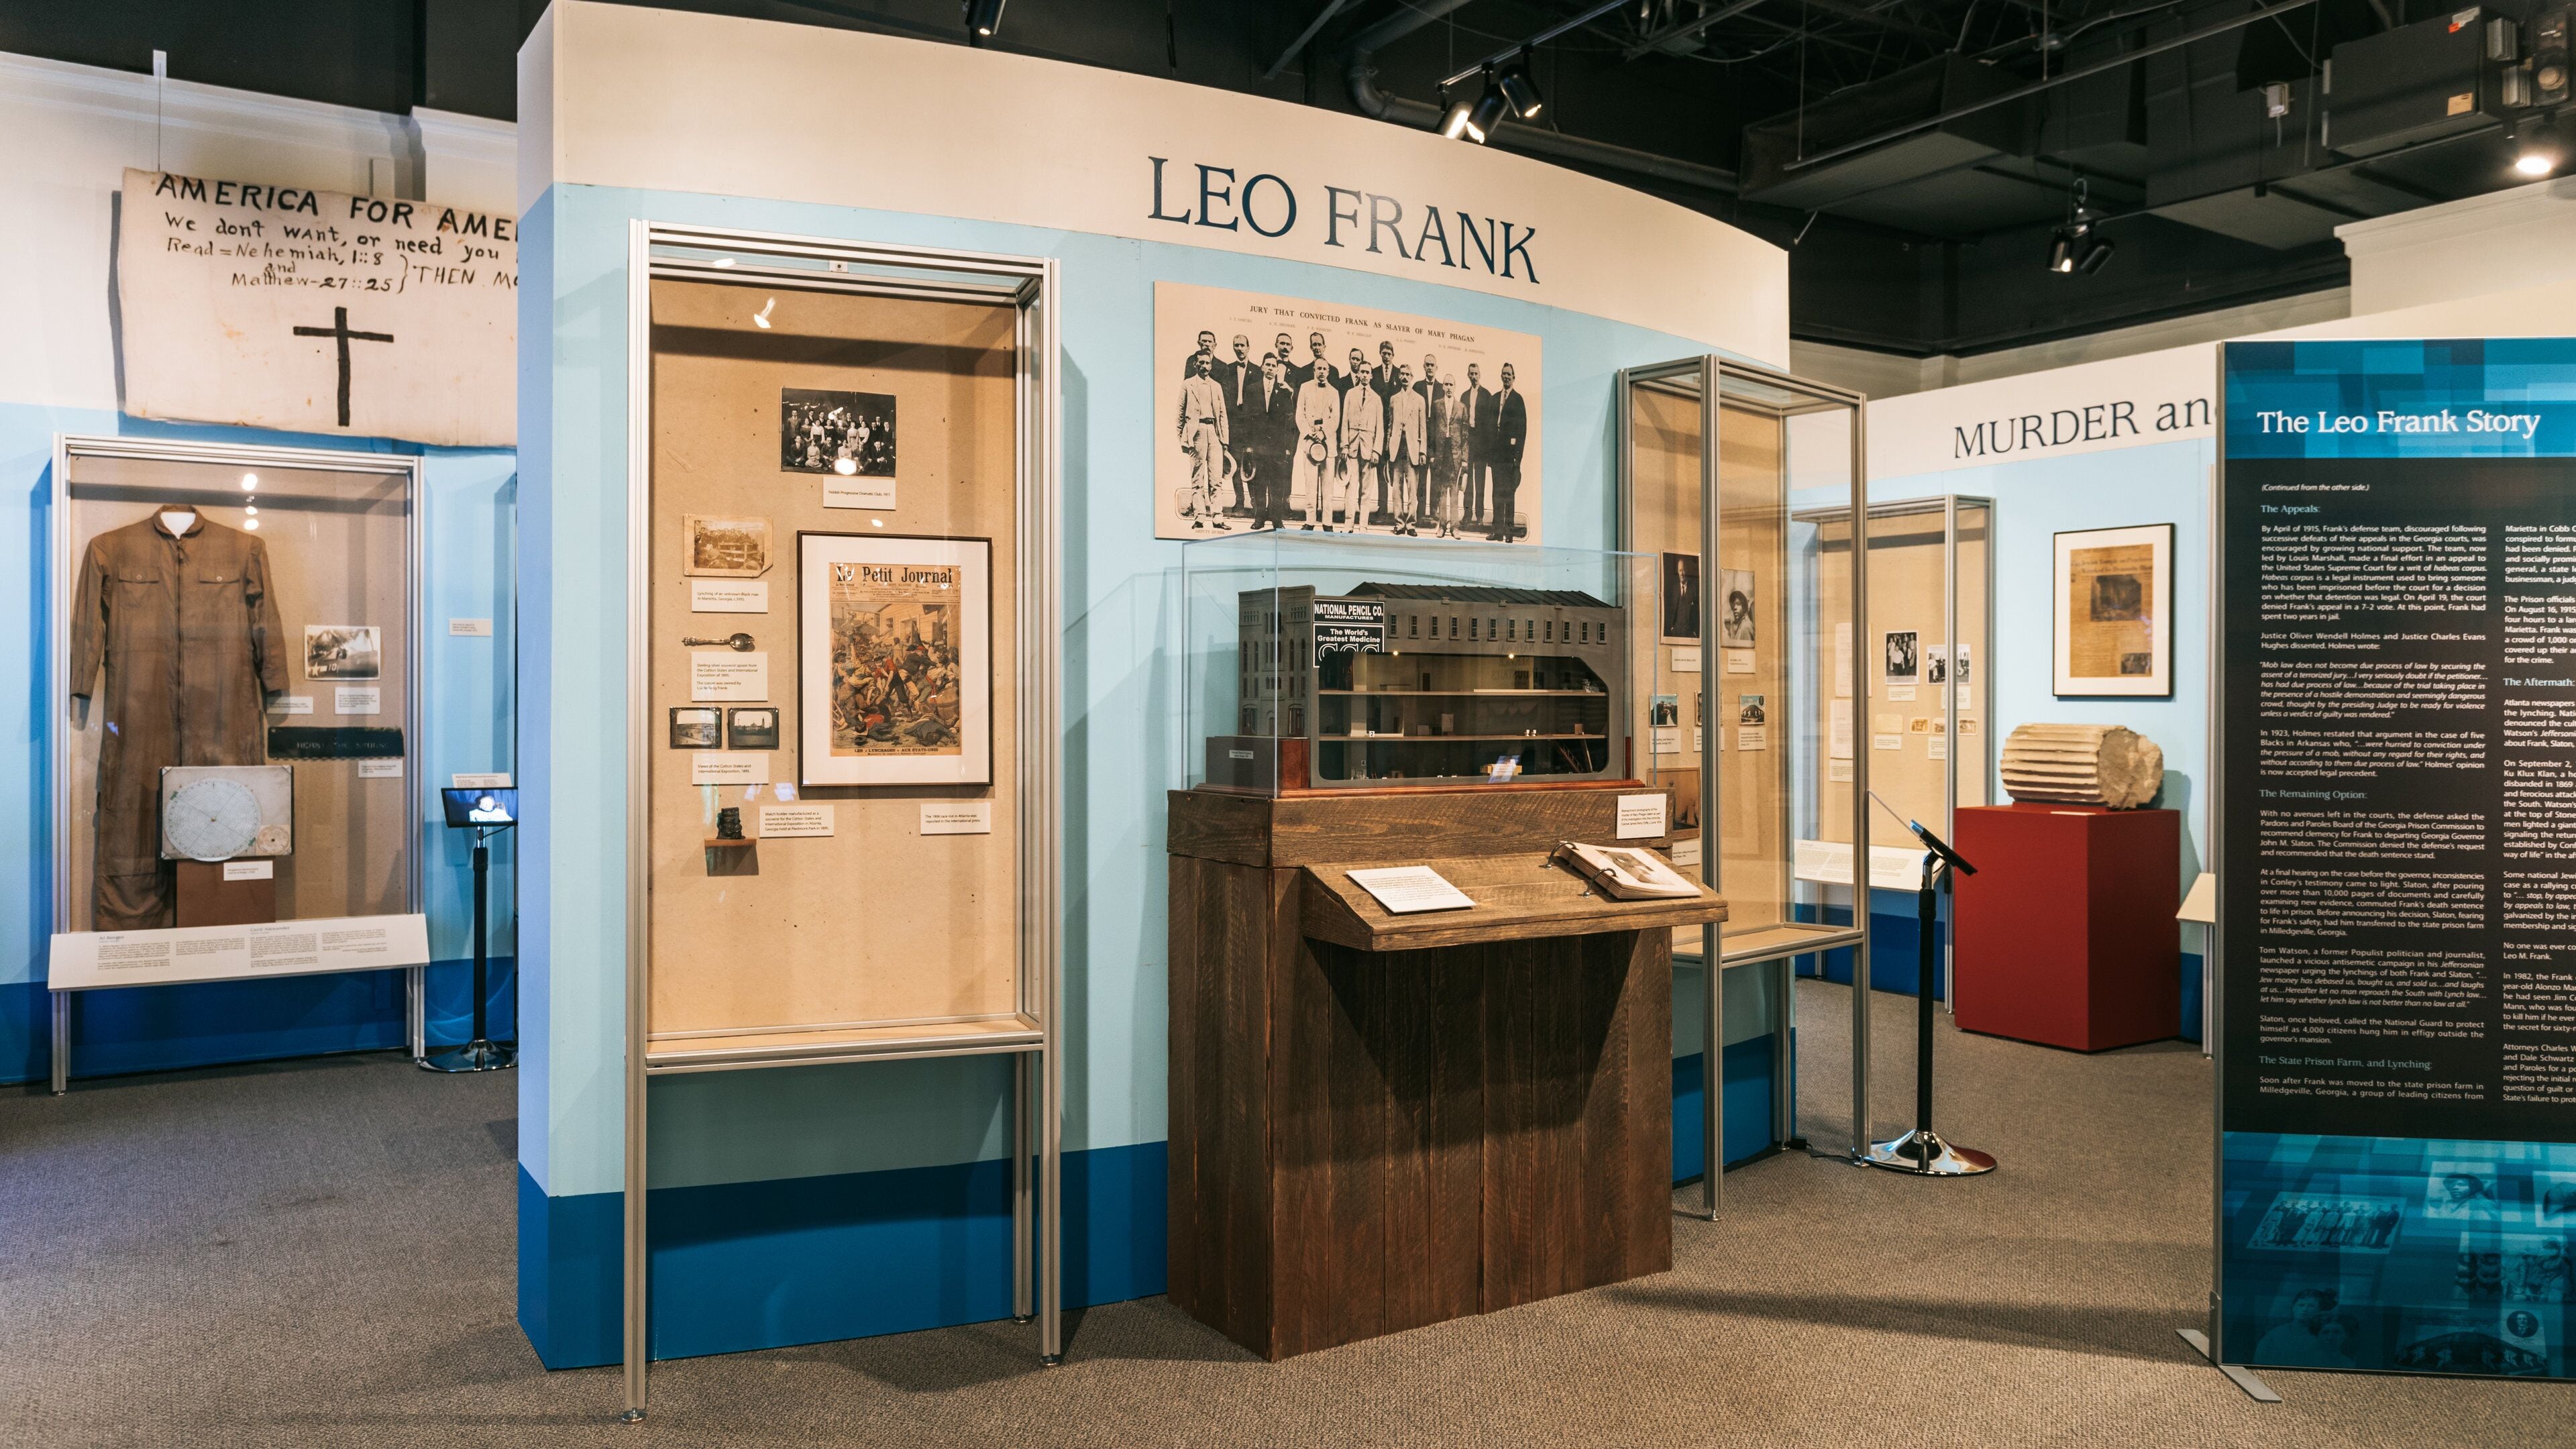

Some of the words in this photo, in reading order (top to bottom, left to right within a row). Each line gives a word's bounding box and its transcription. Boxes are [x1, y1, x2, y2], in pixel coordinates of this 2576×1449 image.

[156, 174, 319, 216] AMERICA
[350, 197, 414, 229] FOR
[1148, 156, 1297, 237] LEO
[1324, 184, 1540, 284] FRANK
[165, 212, 196, 231] We
[357, 235, 380, 248] or
[396, 237, 443, 254] need
[460, 246, 498, 262] you
[265, 261, 296, 274] and
[413, 266, 476, 284] THEN
[1250, 305, 1268, 314] JURY
[1273, 308, 1295, 317] THAT
[1299, 311, 1340, 323] CONVICTED
[1345, 317, 1368, 327] FRANK
[1385, 323, 1411, 333] SLAYER
[1428, 329, 1445, 339] MARY
[1450, 333, 1474, 343] PHAGAN
[1954, 400, 2141, 459] MURDER
[2257, 411, 2308, 433] The
[2318, 412, 2368, 433] Leo
[2377, 409, 2459, 433] Frank
[2467, 411, 2540, 439] Story
[2261, 484, 2300, 492] (Continued
[2300, 483, 2318, 492] from
[2318, 484, 2331, 492] the
[2330, 484, 2351, 492] other
[2260, 504, 2279, 513] The
[2280, 504, 2320, 515] Appeals:
[2261, 525, 2271, 534] By
[2273, 525, 2291, 534] April
[2292, 525, 2300, 533] of
[2303, 525, 2320, 533] 1915,
[2322, 525, 2349, 533] Frank's
[2350, 525, 2379, 533] defense
[2404, 525, 2450, 535] discouraged
[2451, 525, 2487, 535] following
[2300, 534, 2328, 543] defeats
[2328, 535, 2338, 543] of
[2339, 535, 2357, 543] their
[2358, 535, 2387, 543] appeals
[2398, 535, 2412, 543] the
[2412, 535, 2443, 545] Georgia
[2444, 535, 2470, 543] courts,
[2261, 545, 2308, 553] encouraged
[2310, 545, 2320, 553] by
[2322, 545, 2355, 554] growing
[2391, 545, 2424, 553] support.
[2426, 544, 2443, 553] The
[863, 566, 893, 582] Petit
[901, 567, 953, 584] Journal
[1315, 604, 1347, 615] NATIONAL
[1348, 605, 1372, 616] PENCIL
[1373, 606, 1383, 616] CO.
[2502, 678, 2522, 687] The
[2523, 678, 2575, 687] Aftermath:
[2271, 729, 2290, 737] 1923,
[2323, 730, 2355, 738] restated
[2375, 732, 2412, 740] argument
[2424, 731, 2438, 739] the
[2459, 731, 2469, 739] of
[2469, 731, 2485, 740] five
[2259, 789, 2277, 798] The
[2279, 790, 2331, 801] Remaining
[2332, 790, 2367, 801] Option:
[2503, 952, 2518, 960] Leo
[2518, 952, 2528, 960] M.
[2529, 952, 2552, 961] Frank.
[2258, 1055, 2277, 1065] The
[2278, 1056, 2302, 1065] State
[2304, 1057, 2334, 1066] Prison
[2337, 1058, 2364, 1067] Farm,
[2366, 1059, 2385, 1068] and
[2387, 1059, 2432, 1072] Lynching:
